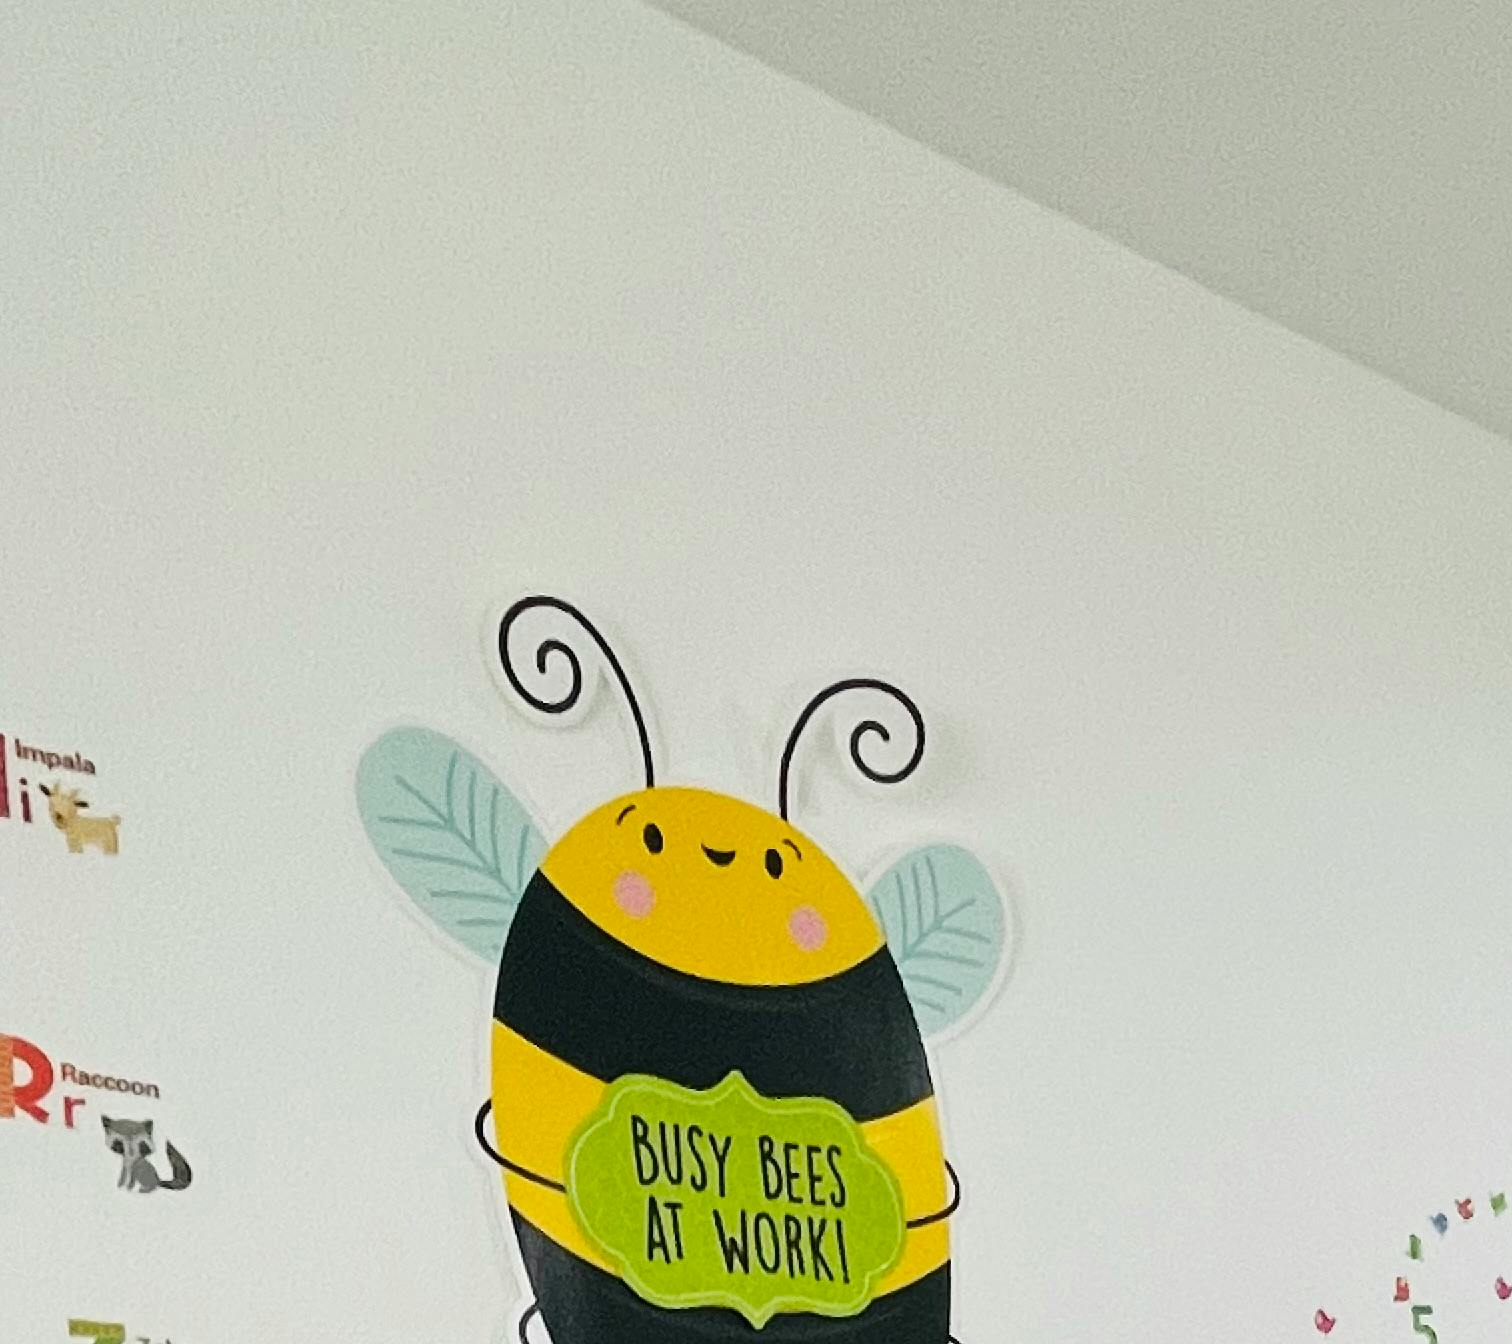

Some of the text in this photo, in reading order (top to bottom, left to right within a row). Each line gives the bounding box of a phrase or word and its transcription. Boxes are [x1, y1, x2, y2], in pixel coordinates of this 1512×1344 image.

[14, 738, 96, 775] Impala
[60, 1062, 160, 1099] Raccoon
[629, 1114, 846, 1208] BUSY BEES
[646, 1195, 850, 1284] AT WORK!
